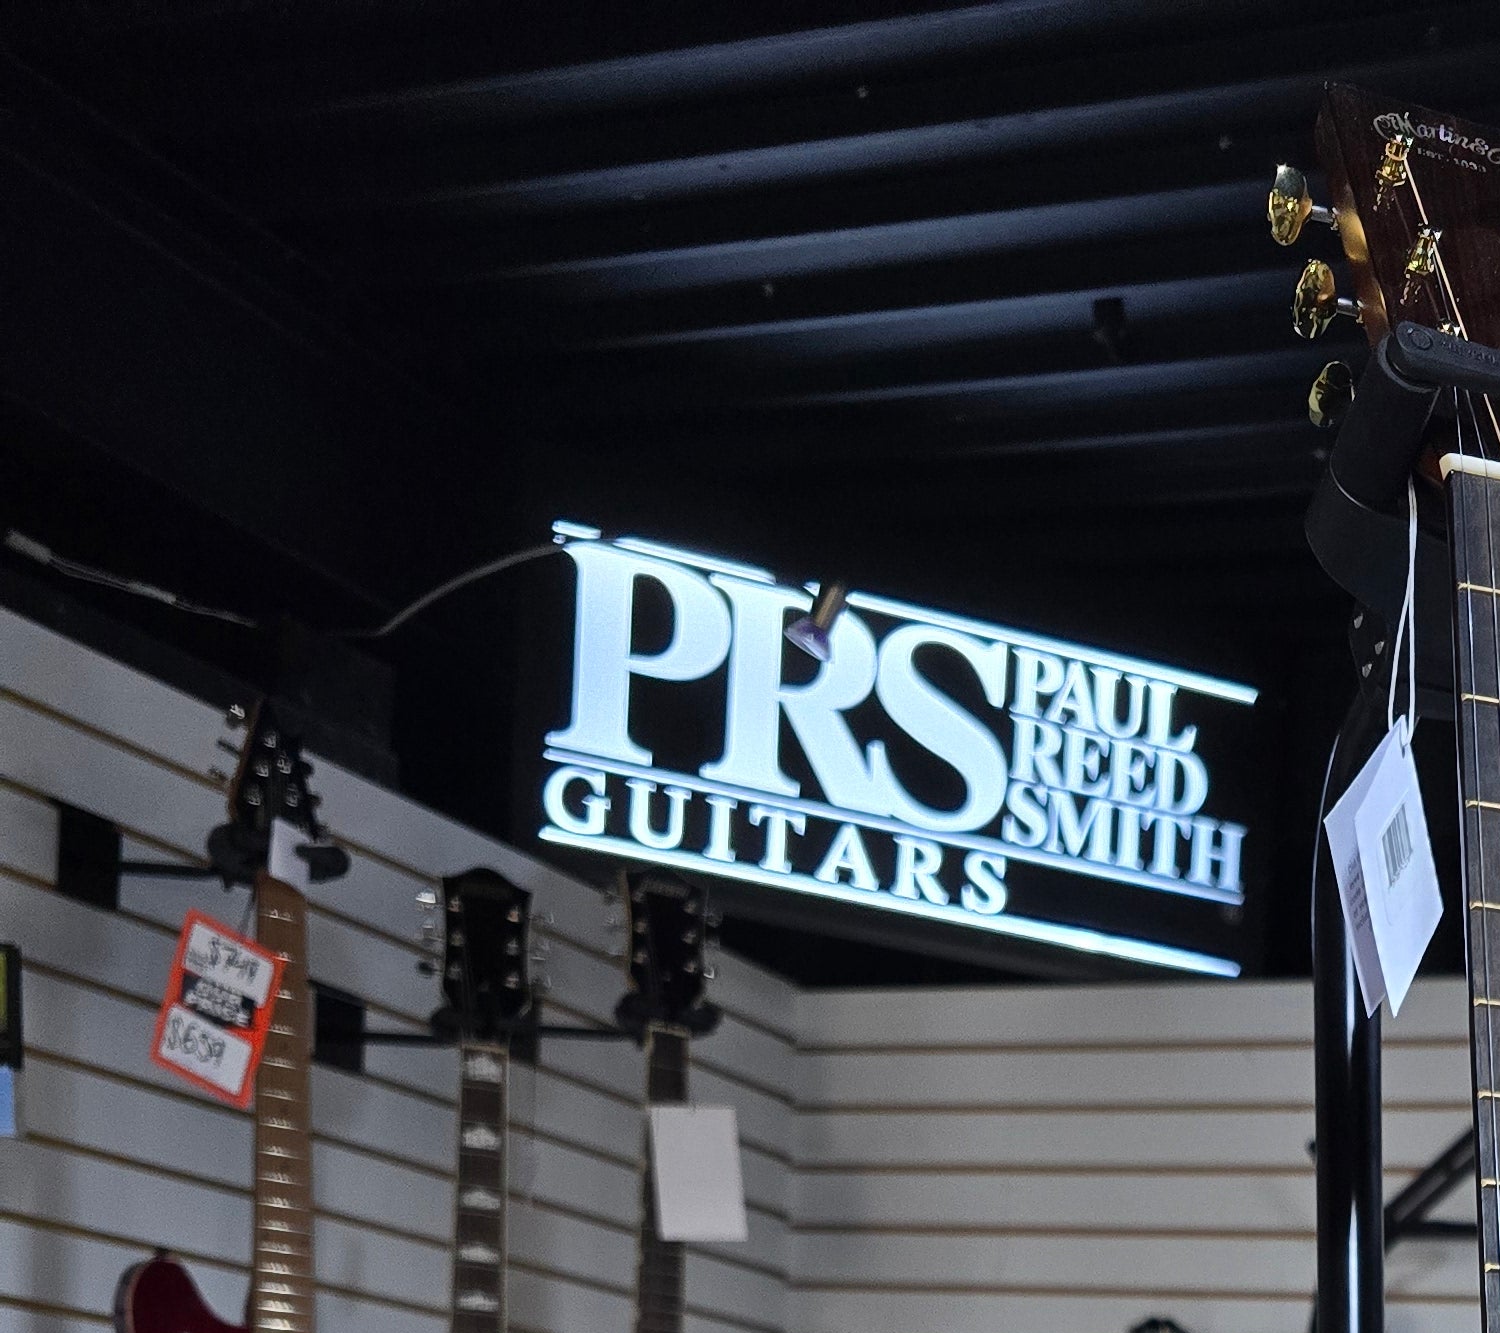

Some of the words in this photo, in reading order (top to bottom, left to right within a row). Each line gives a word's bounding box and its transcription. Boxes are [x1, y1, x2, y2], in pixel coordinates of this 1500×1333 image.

[545, 536, 1008, 834] PRS
[1010, 645, 1198, 754] PAUL
[1009, 712, 1210, 818] REED
[543, 765, 1009, 916] GUITARS
[1002, 781, 1248, 893] SMITH
